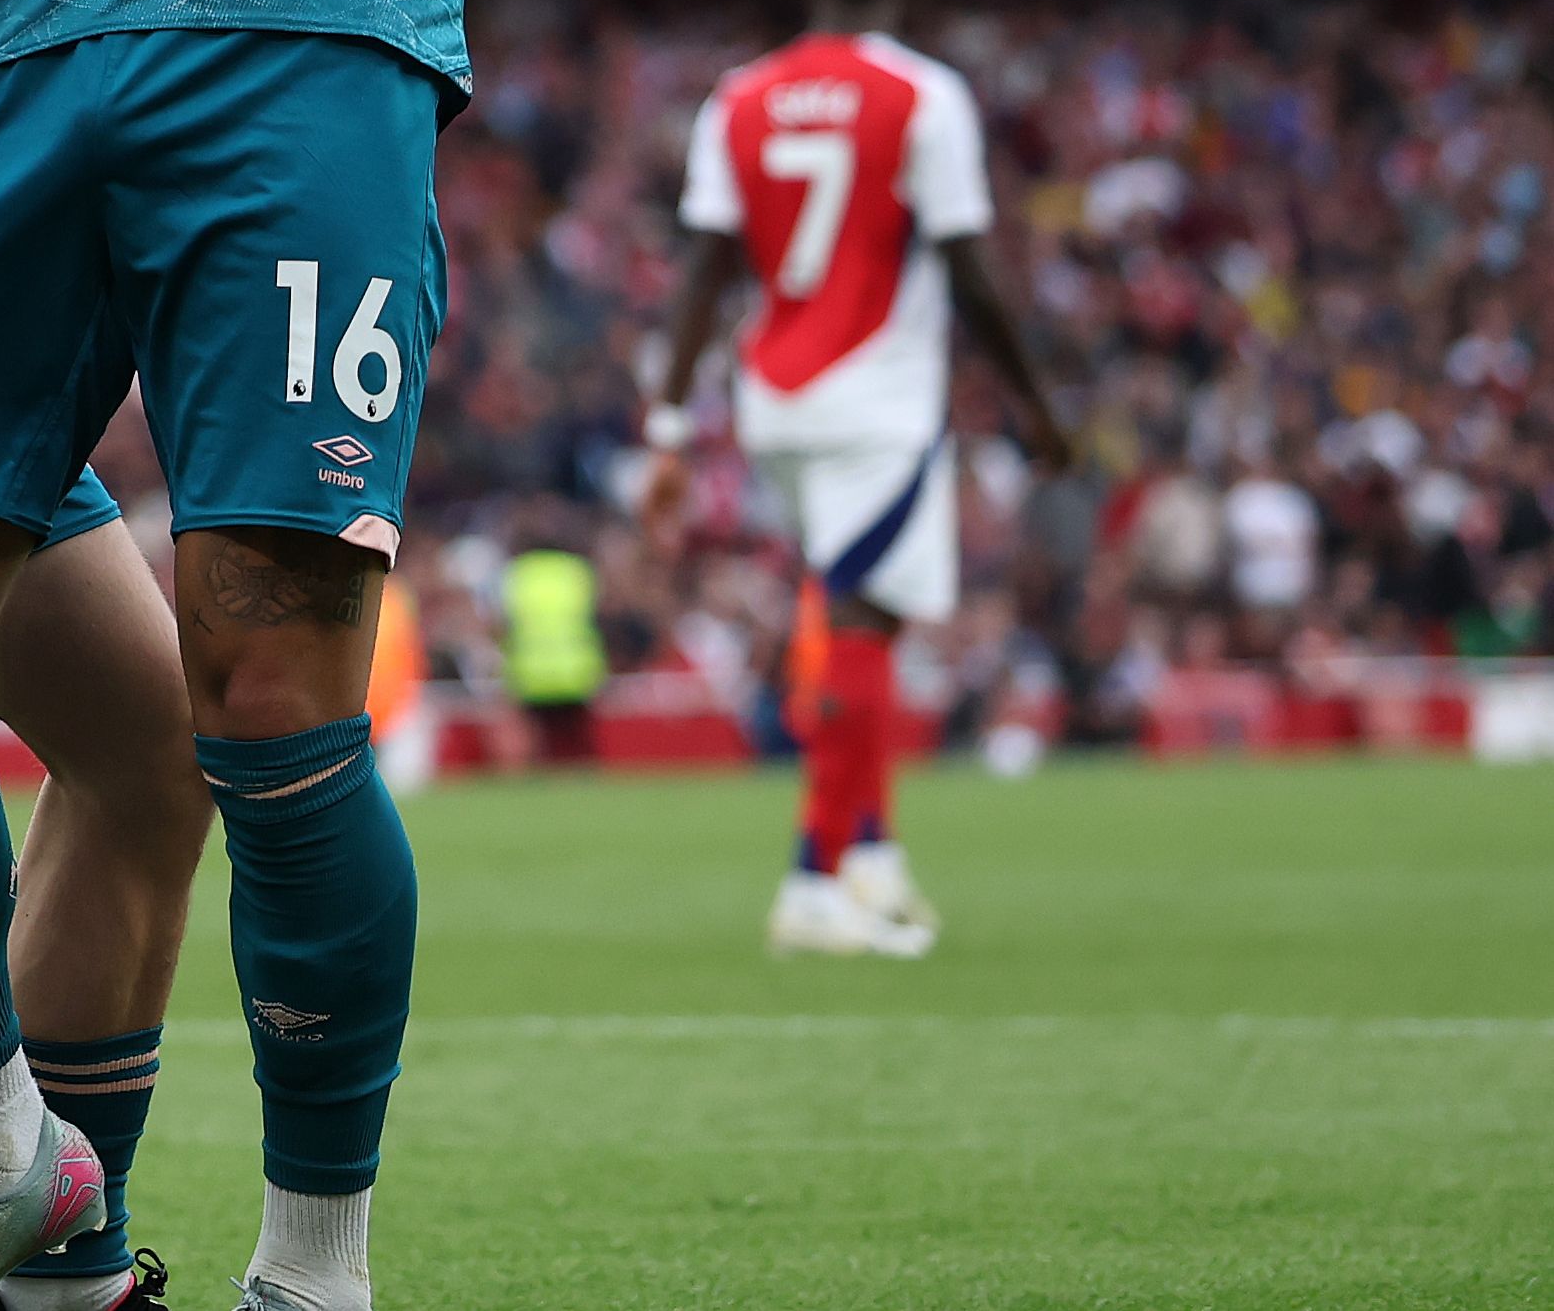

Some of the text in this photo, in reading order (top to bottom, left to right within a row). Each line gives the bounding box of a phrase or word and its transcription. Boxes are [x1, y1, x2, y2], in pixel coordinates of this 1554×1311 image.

[760, 131, 856, 300] 7
[275, 259, 402, 423] 16
[318, 468, 365, 489] umbro
